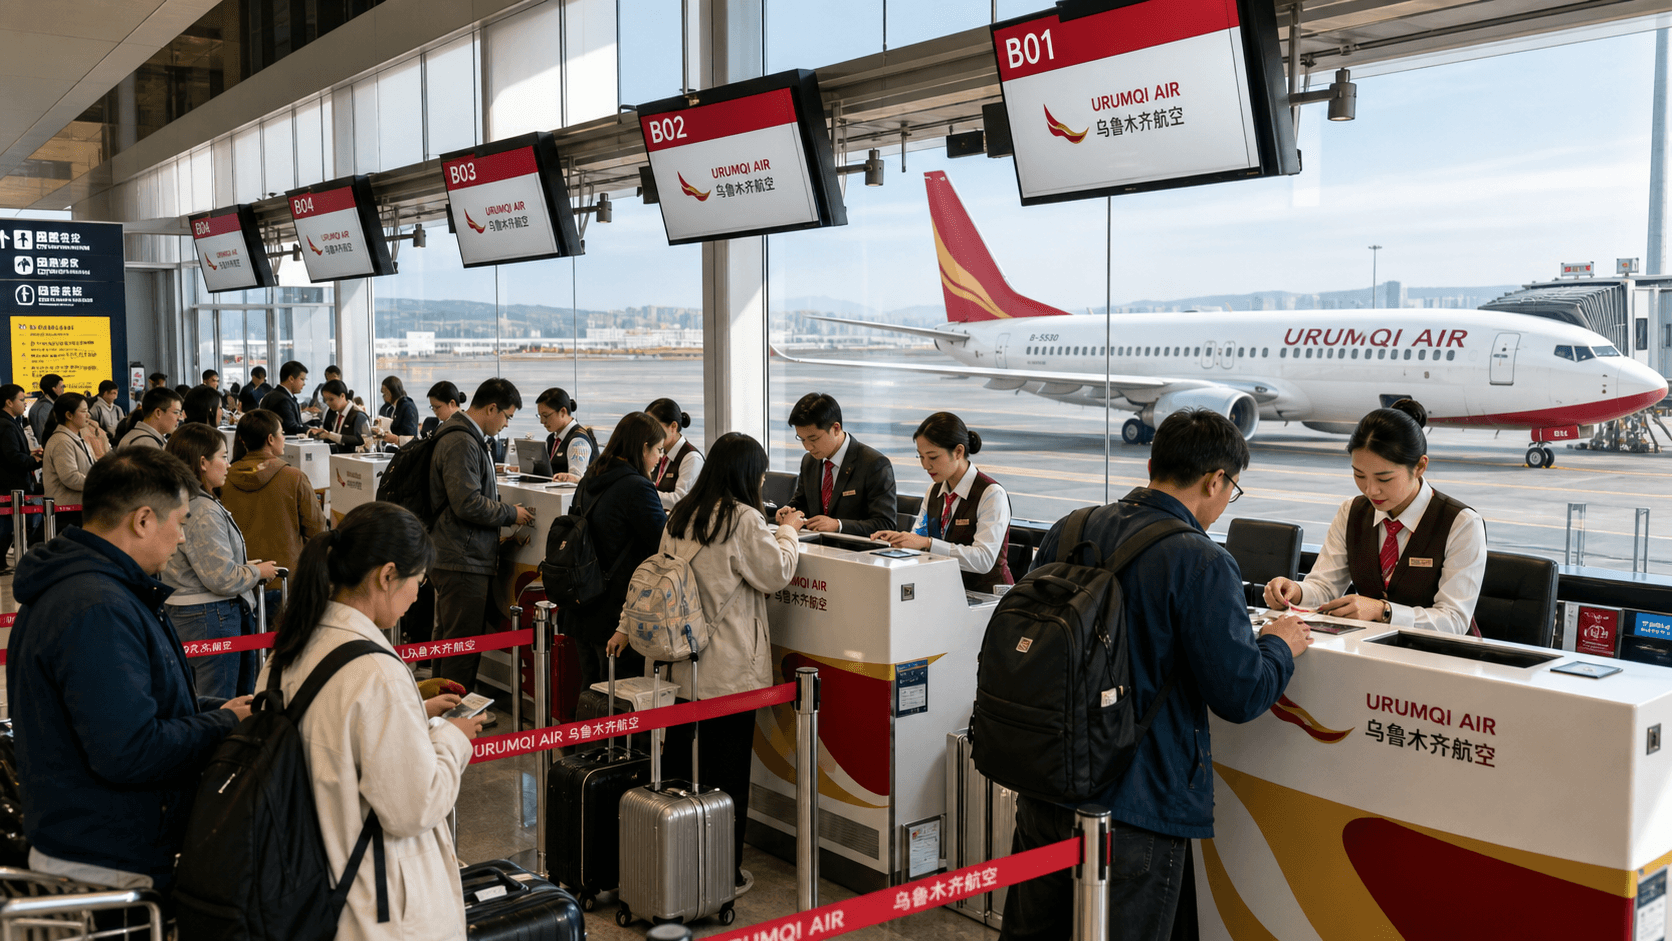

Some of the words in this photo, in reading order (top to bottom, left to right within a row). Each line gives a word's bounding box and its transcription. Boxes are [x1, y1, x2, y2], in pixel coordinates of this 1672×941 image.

[1005, 28, 1055, 69] B01
[1091, 87, 1149, 112] URUMQI
[1155, 81, 1181, 100] AIR
[649, 115, 688, 144] B02
[1096, 106, 1185, 138] 乌鲁木齐航空
[450, 162, 477, 184] B03
[711, 161, 751, 179] URUMQI
[753, 158, 771, 173] AIR
[294, 197, 314, 215] B04
[1284, 328, 1403, 348] URUMQI
[1411, 329, 1468, 348] AIR
[811, 579, 827, 592] AIR
[1366, 693, 1451, 726] URUMQI
[1459, 713, 1497, 736] AIR
[473, 734, 536, 758] URUMQI
[539, 730, 563, 747] AIR
[1365, 719, 1496, 768] 乌鲁木齐航空
[808, 909, 845, 936] AIR
[893, 866, 998, 911] 乌鲁木齐航空
